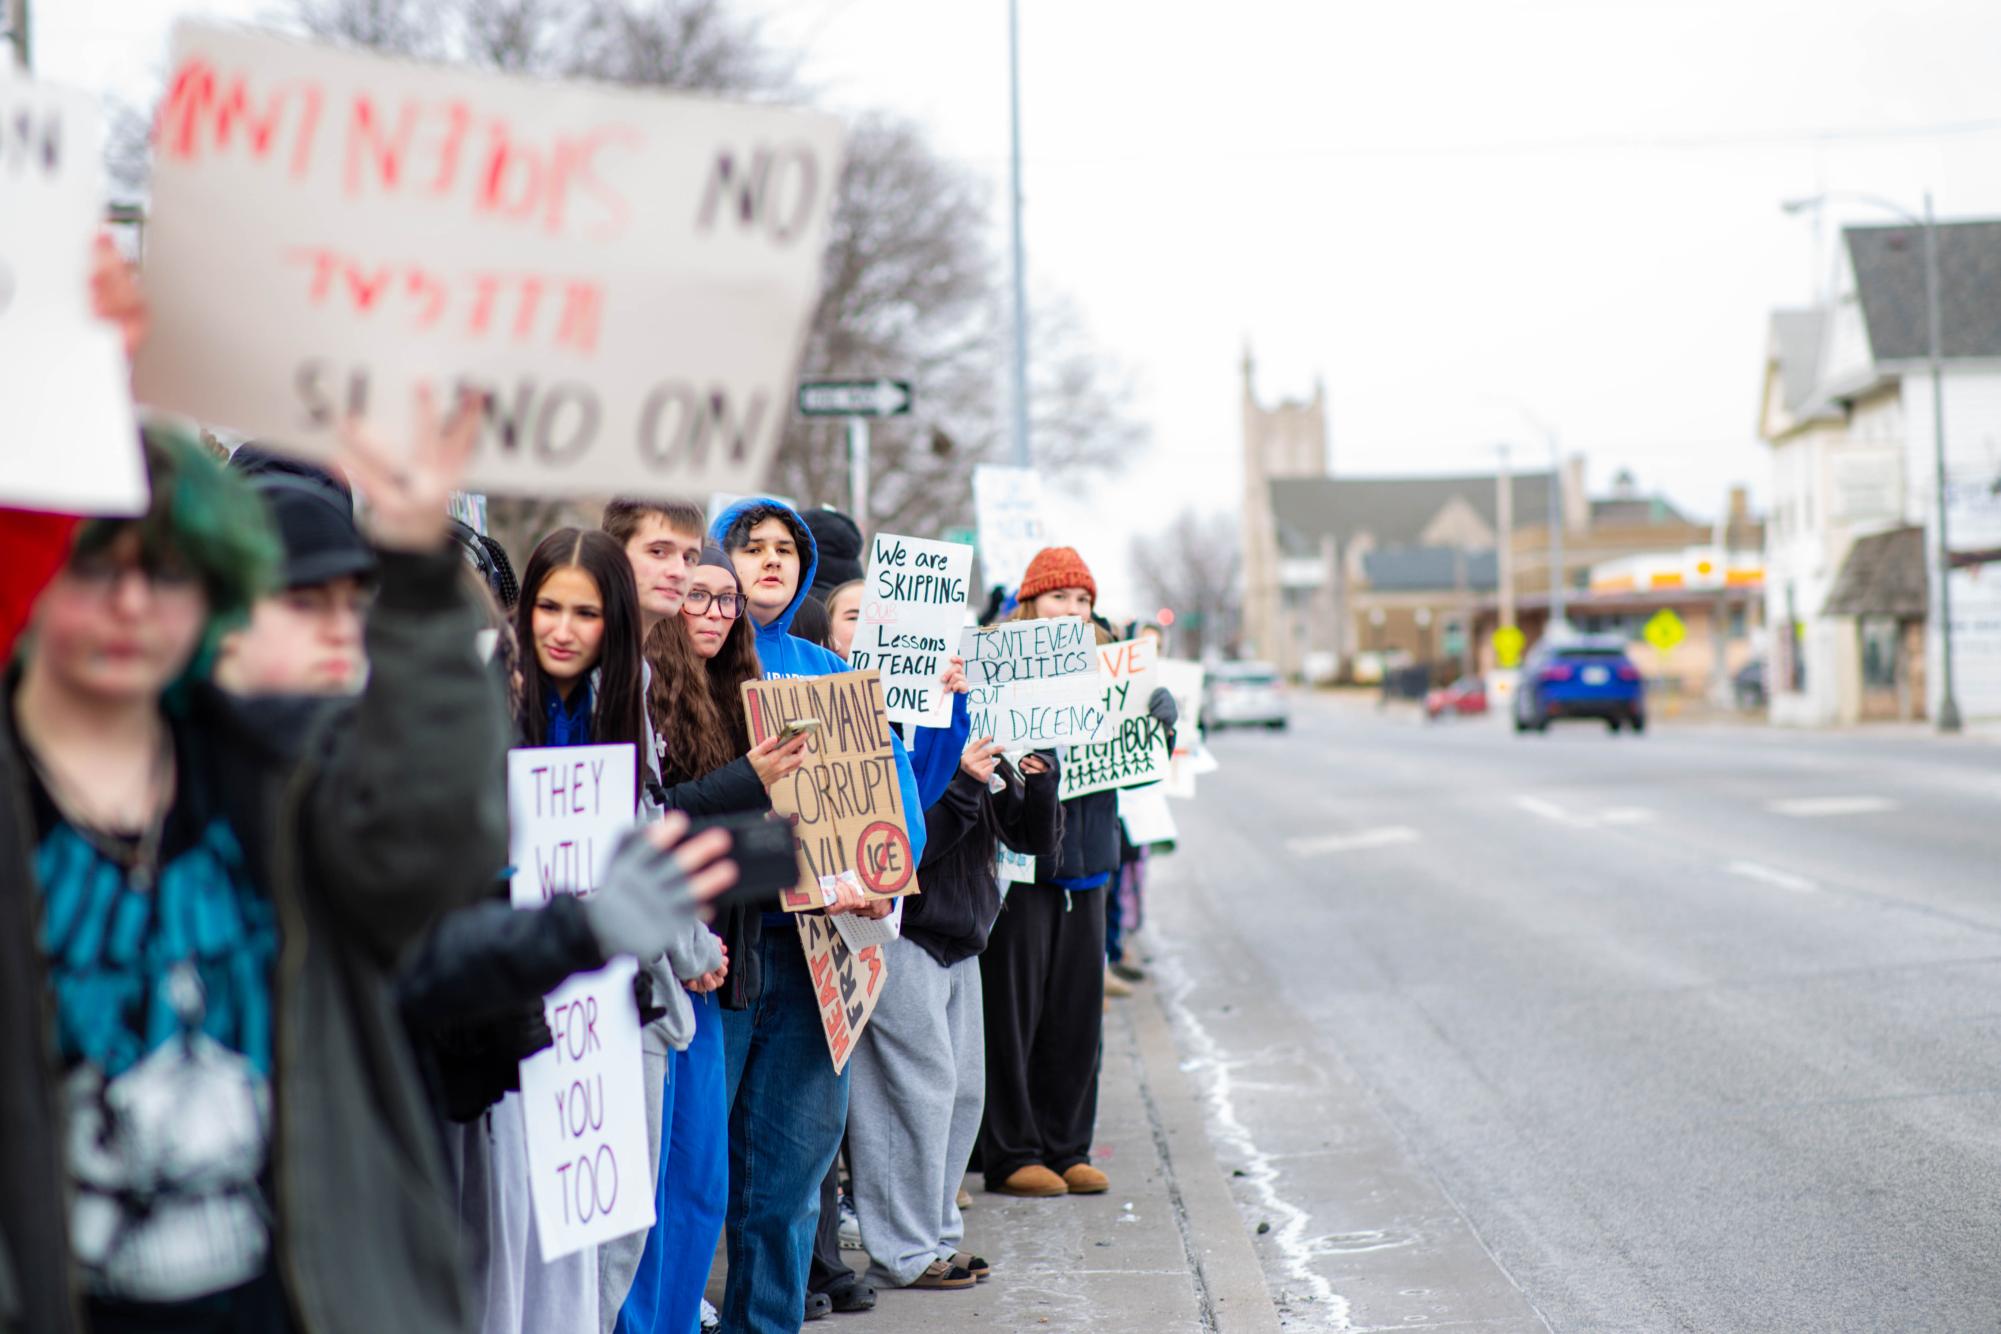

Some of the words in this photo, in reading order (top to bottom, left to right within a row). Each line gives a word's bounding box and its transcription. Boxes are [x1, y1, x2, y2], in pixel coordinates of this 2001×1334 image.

[698, 146, 818, 246] ON
[457, 382, 601, 470] ON
[637, 383, 765, 475] NO
[876, 538, 907, 567] We
[915, 552, 948, 571] are
[878, 570, 965, 605] SKIPPING
[851, 650, 871, 671] TO
[877, 653, 937, 676] TEACH
[877, 624, 946, 652] Lessons
[982, 652, 1088, 685] POLITICS
[1035, 622, 1085, 656] EVEN
[1102, 640, 1148, 678] VE
[886, 686, 930, 713] ONE
[531, 758, 605, 819] THEY
[780, 755, 897, 826] ORRUPT
[535, 836, 600, 901] WILL
[867, 842, 902, 875] ICE
[554, 995, 602, 1065] FOR
[809, 951, 850, 1064] HEAT
[554, 1073, 604, 1141] YOU
[556, 1143, 618, 1227] TOO
